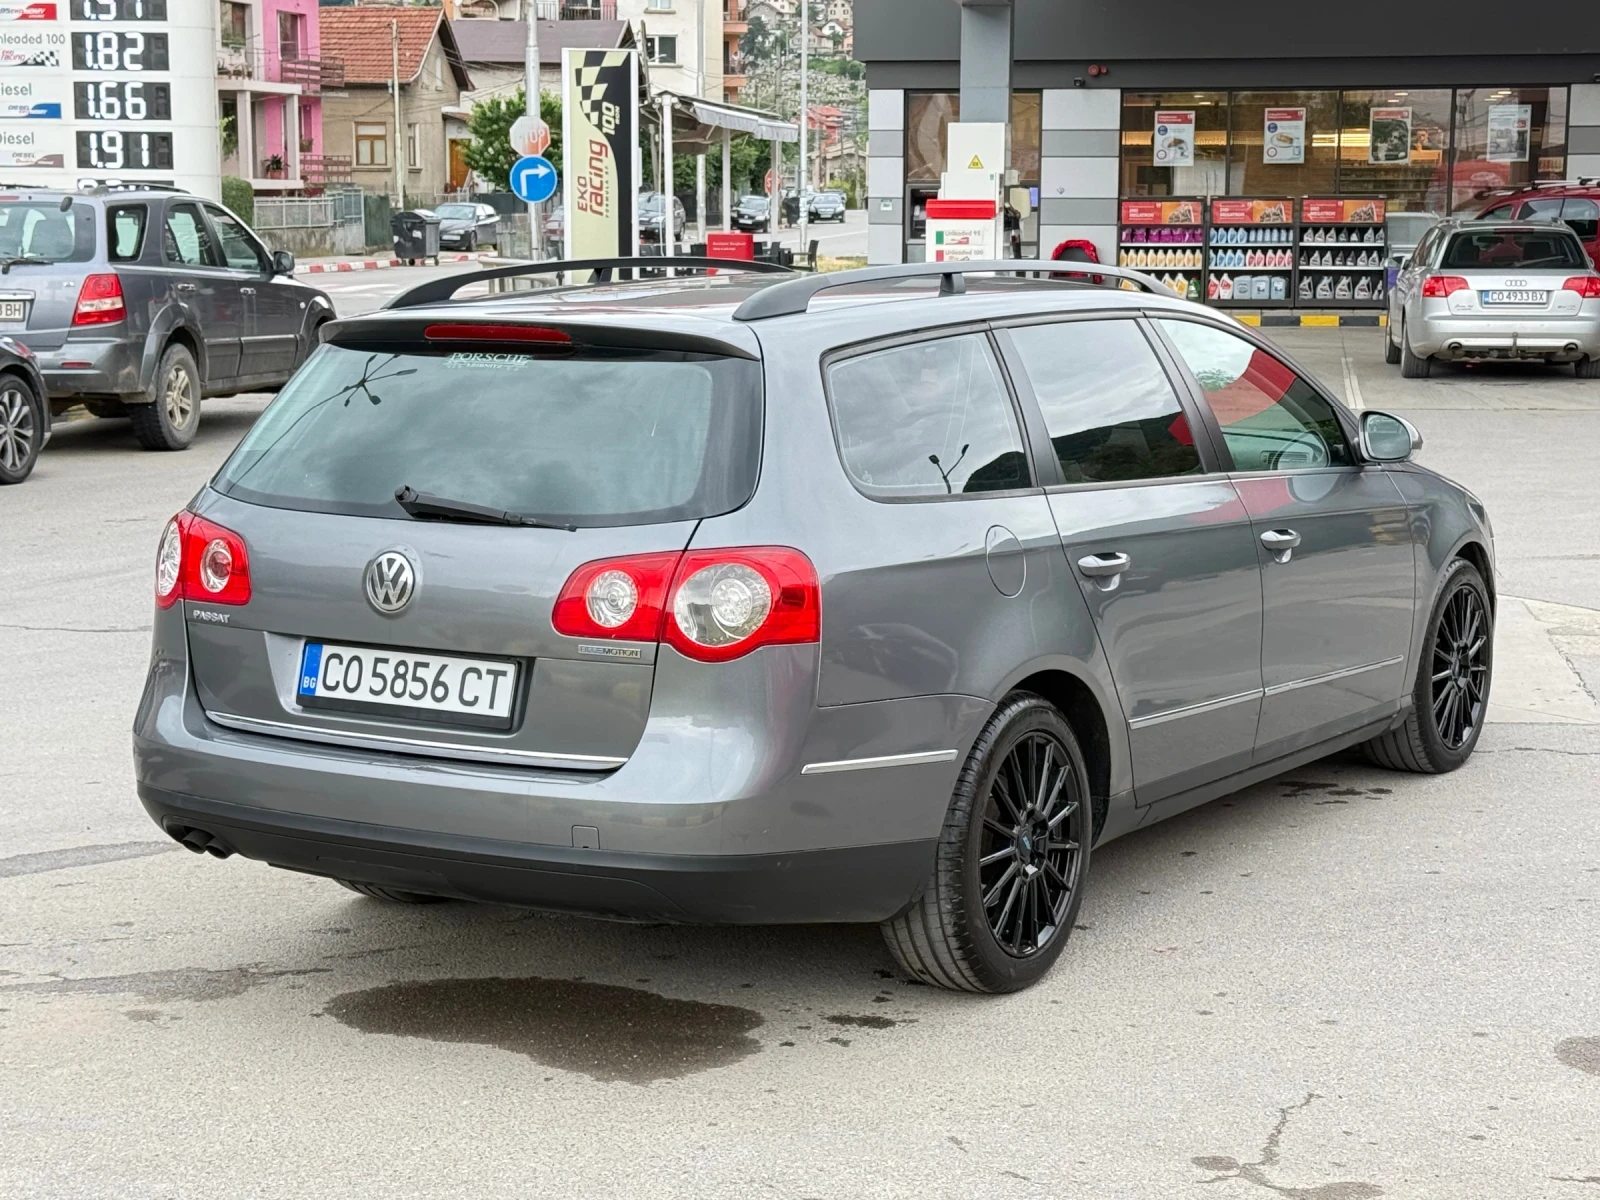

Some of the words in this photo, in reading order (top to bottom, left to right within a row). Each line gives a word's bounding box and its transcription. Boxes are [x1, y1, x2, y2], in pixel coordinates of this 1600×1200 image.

[46, 33, 66, 44] 100
[85, 32, 144, 70] 1.82
[87, 81, 147, 119] 1.66
[602, 101, 615, 135] 100
[89, 131, 149, 169] 1.91
[577, 176, 587, 212] EKO
[589, 139, 608, 216] racing
[6, 303, 21, 316] BH
[1506, 291, 1530, 301] 4933
[1531, 291, 1545, 301] BX
[450, 352, 531, 363] PORSCHE
[193, 609, 230, 623] PASSAT
[303, 676, 317, 689] BG
[322, 653, 363, 694] CO
[369, 657, 449, 703] 5856
[458, 667, 508, 710] CT
